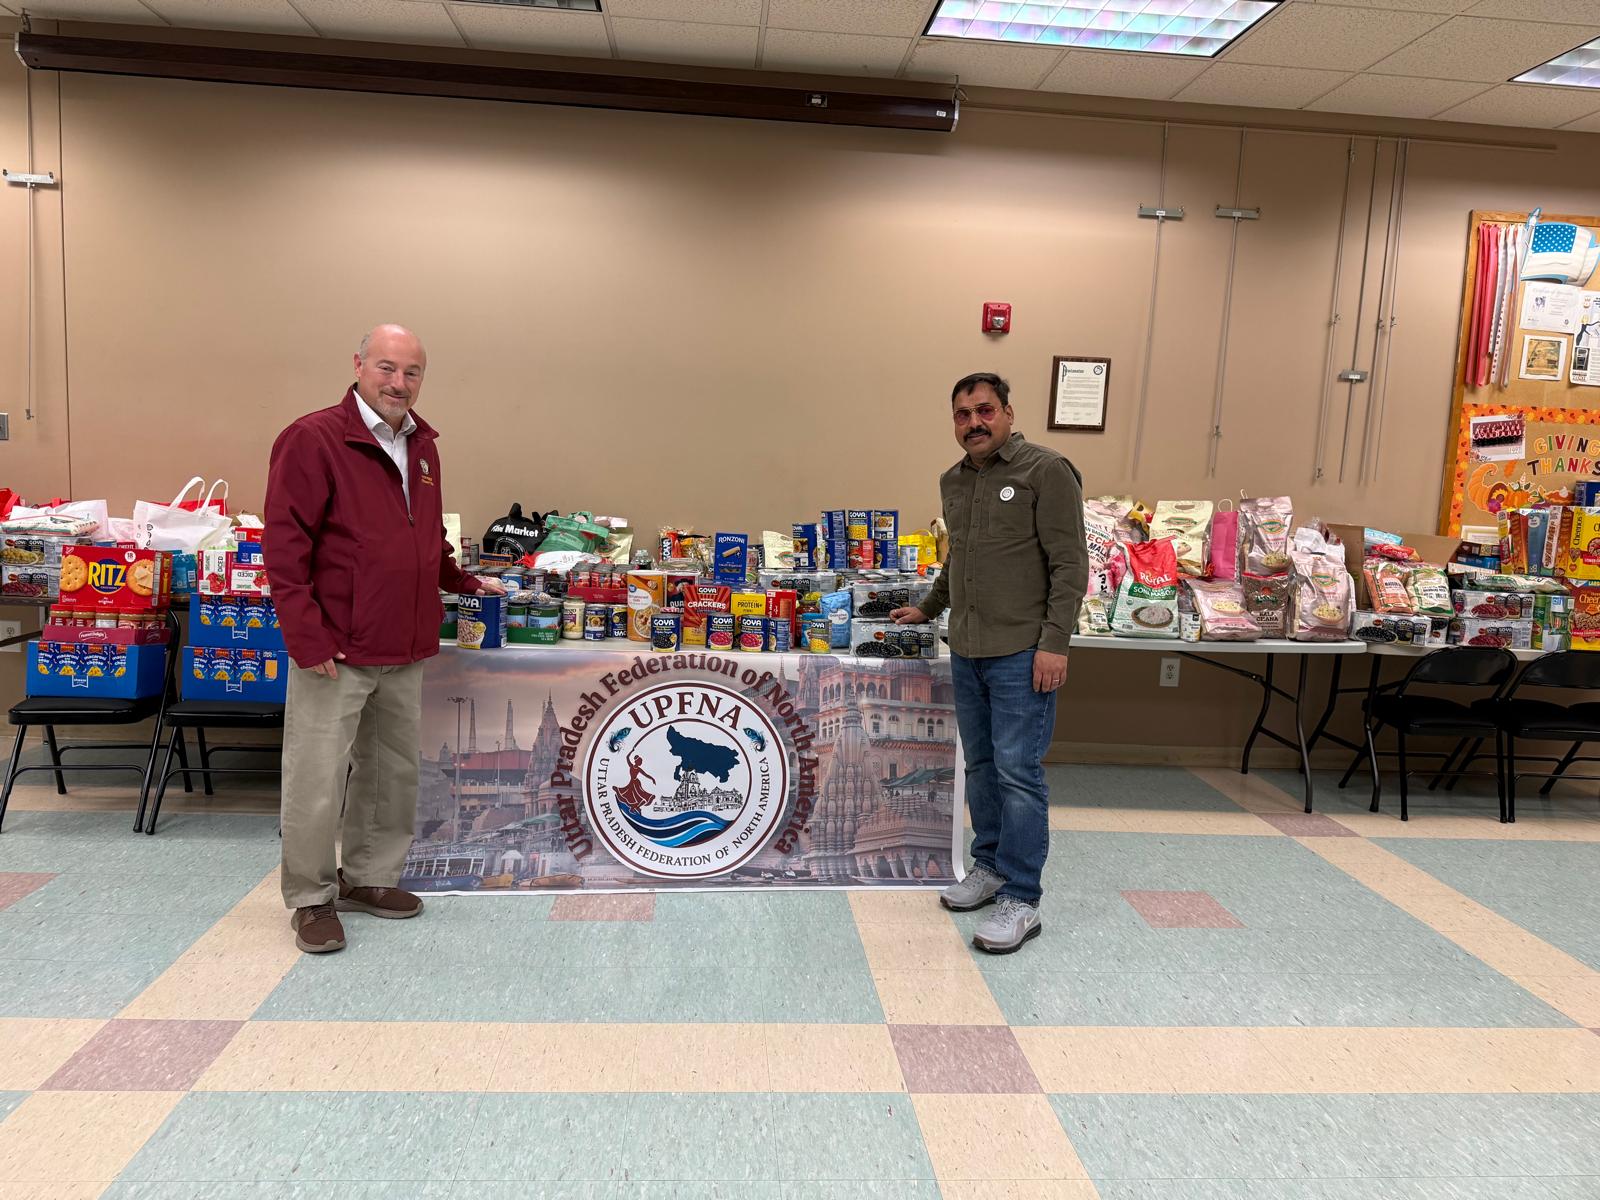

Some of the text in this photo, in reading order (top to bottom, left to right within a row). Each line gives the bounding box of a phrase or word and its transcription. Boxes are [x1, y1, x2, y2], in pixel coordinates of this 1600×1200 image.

[1533, 434, 1600, 456] GIVING
[1527, 457, 1600, 476] THANKS
[504, 524, 539, 538] Market
[718, 536, 745, 544] RONZONI
[1573, 516, 1583, 546] Cheerios
[88, 561, 127, 587] RITZ
[1140, 572, 1171, 585] ROYAL
[459, 597, 481, 609] OYA
[687, 601, 727, 610] CRACKERS
[628, 692, 744, 730] UPFNA
[551, 653, 819, 862] Uttar Pradesh Federation of North America
[597, 757, 771, 867] UTTAR PRADESH FEDERATION OF NORTH AMERICA
